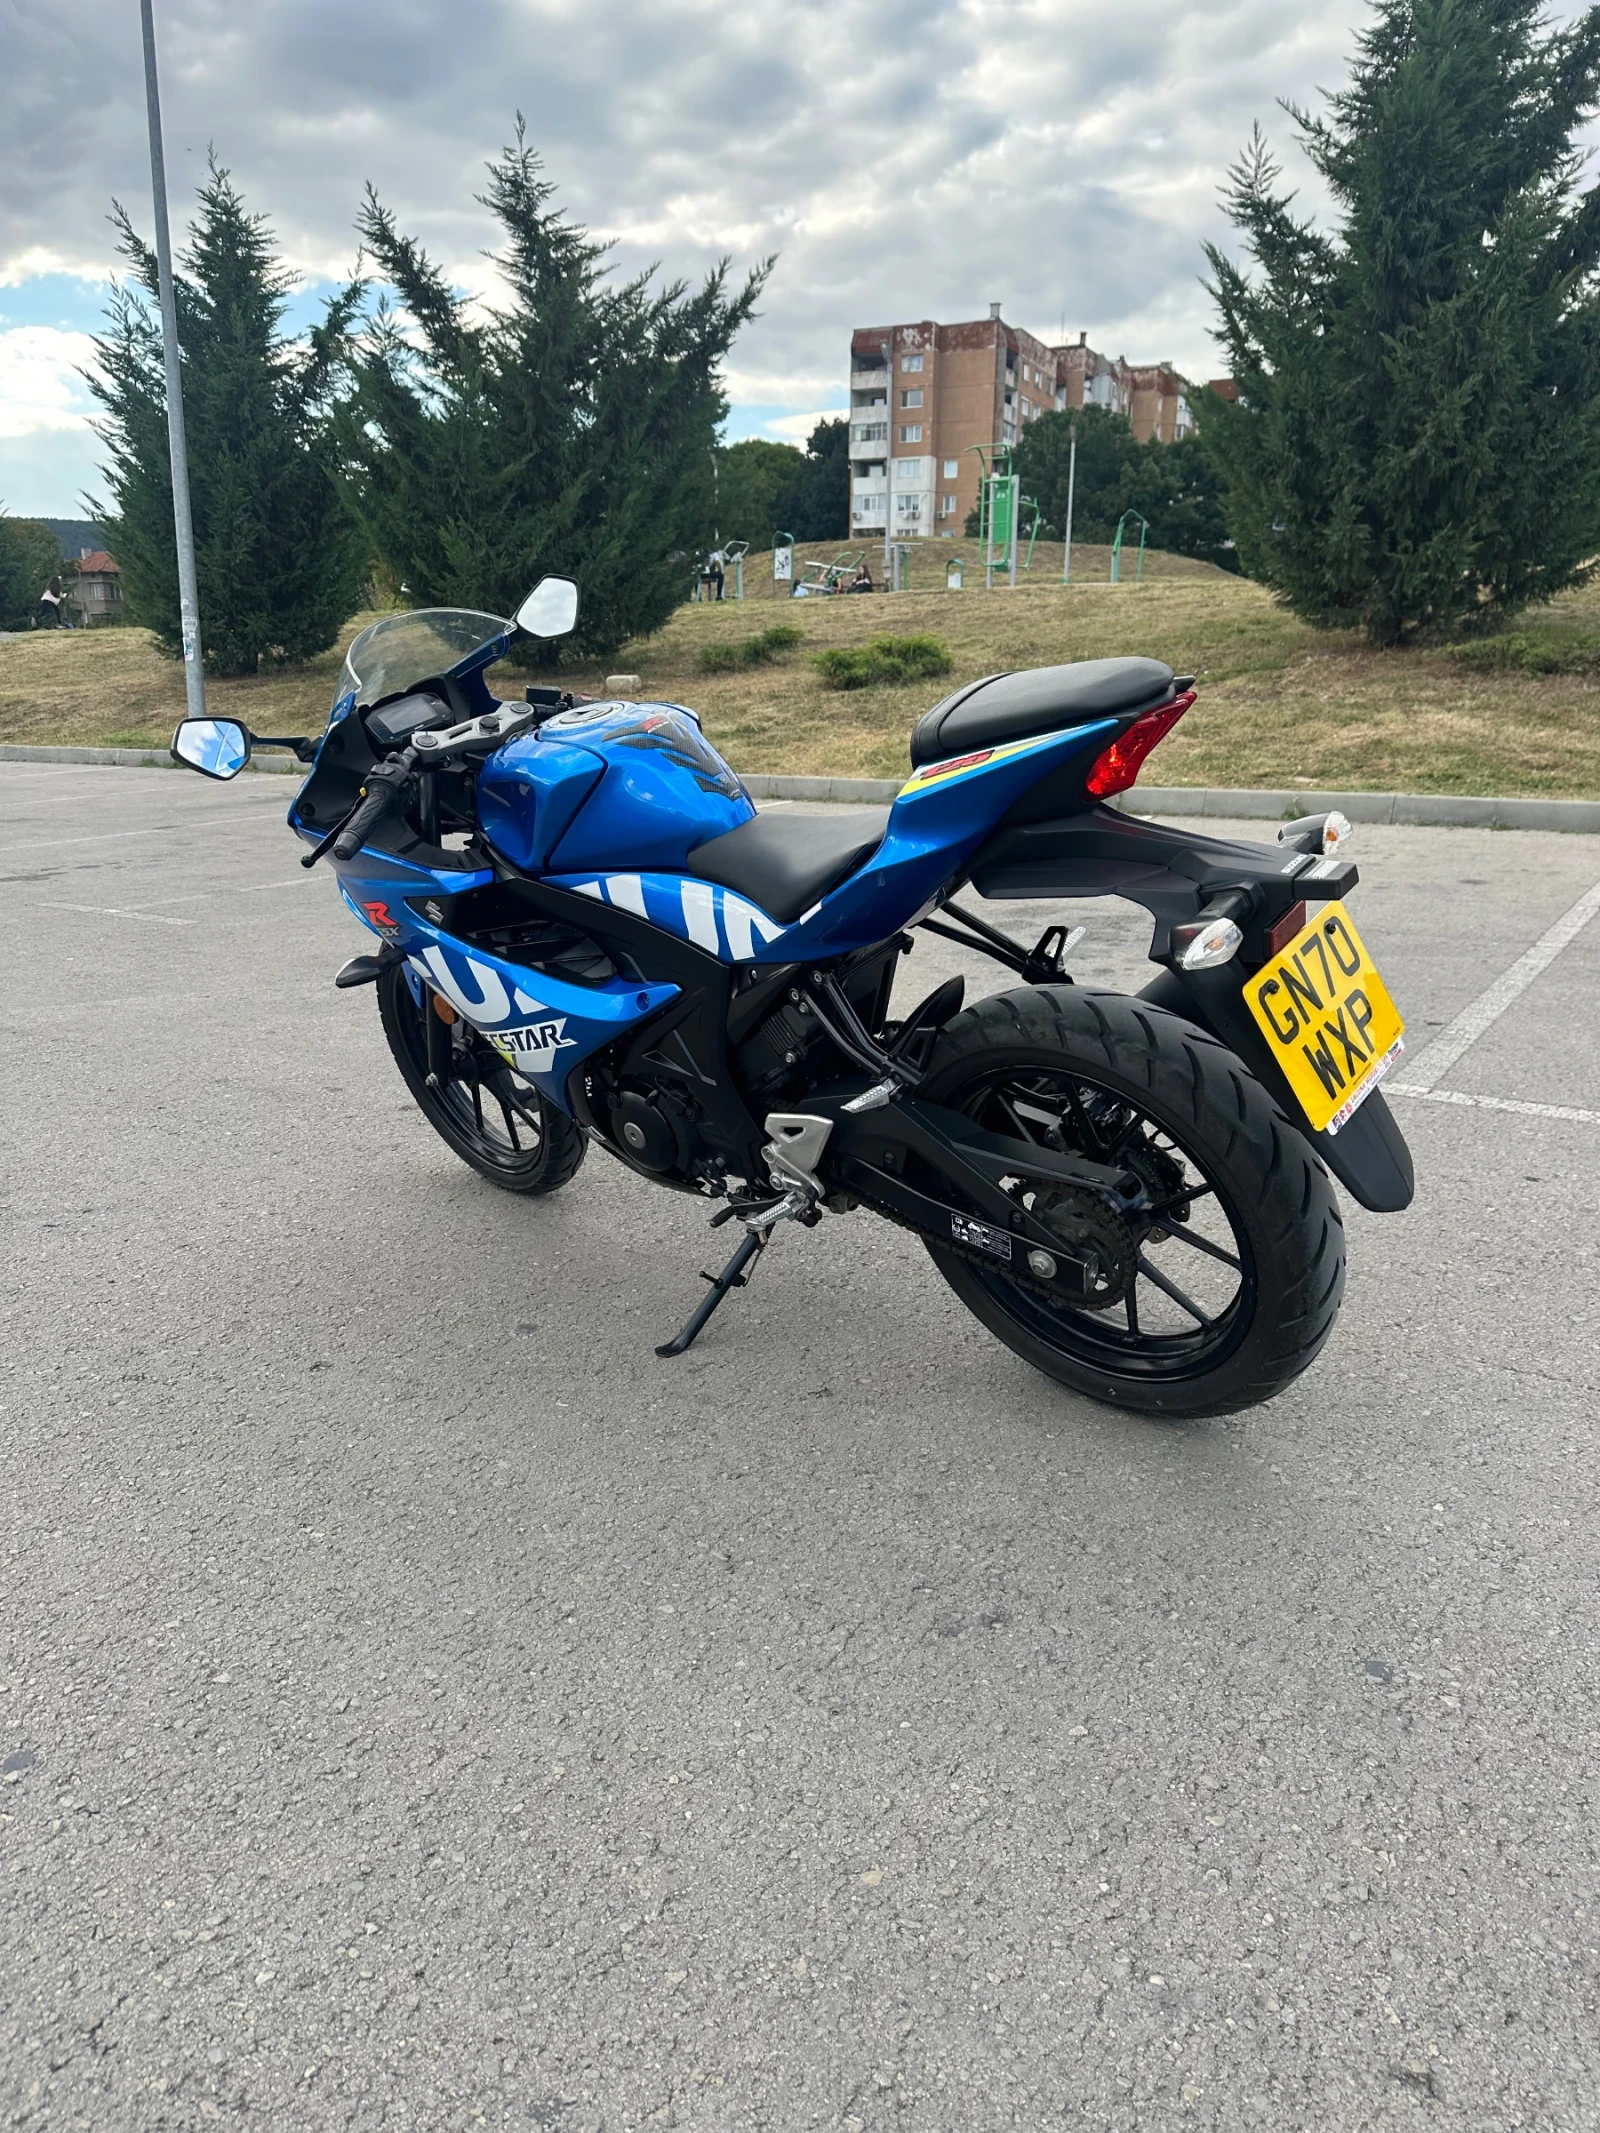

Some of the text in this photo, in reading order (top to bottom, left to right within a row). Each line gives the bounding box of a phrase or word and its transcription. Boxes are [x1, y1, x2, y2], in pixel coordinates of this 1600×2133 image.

[362, 901, 397, 926] R
[1258, 915, 1361, 1045] GN70
[1302, 988, 1376, 1101] WXP
